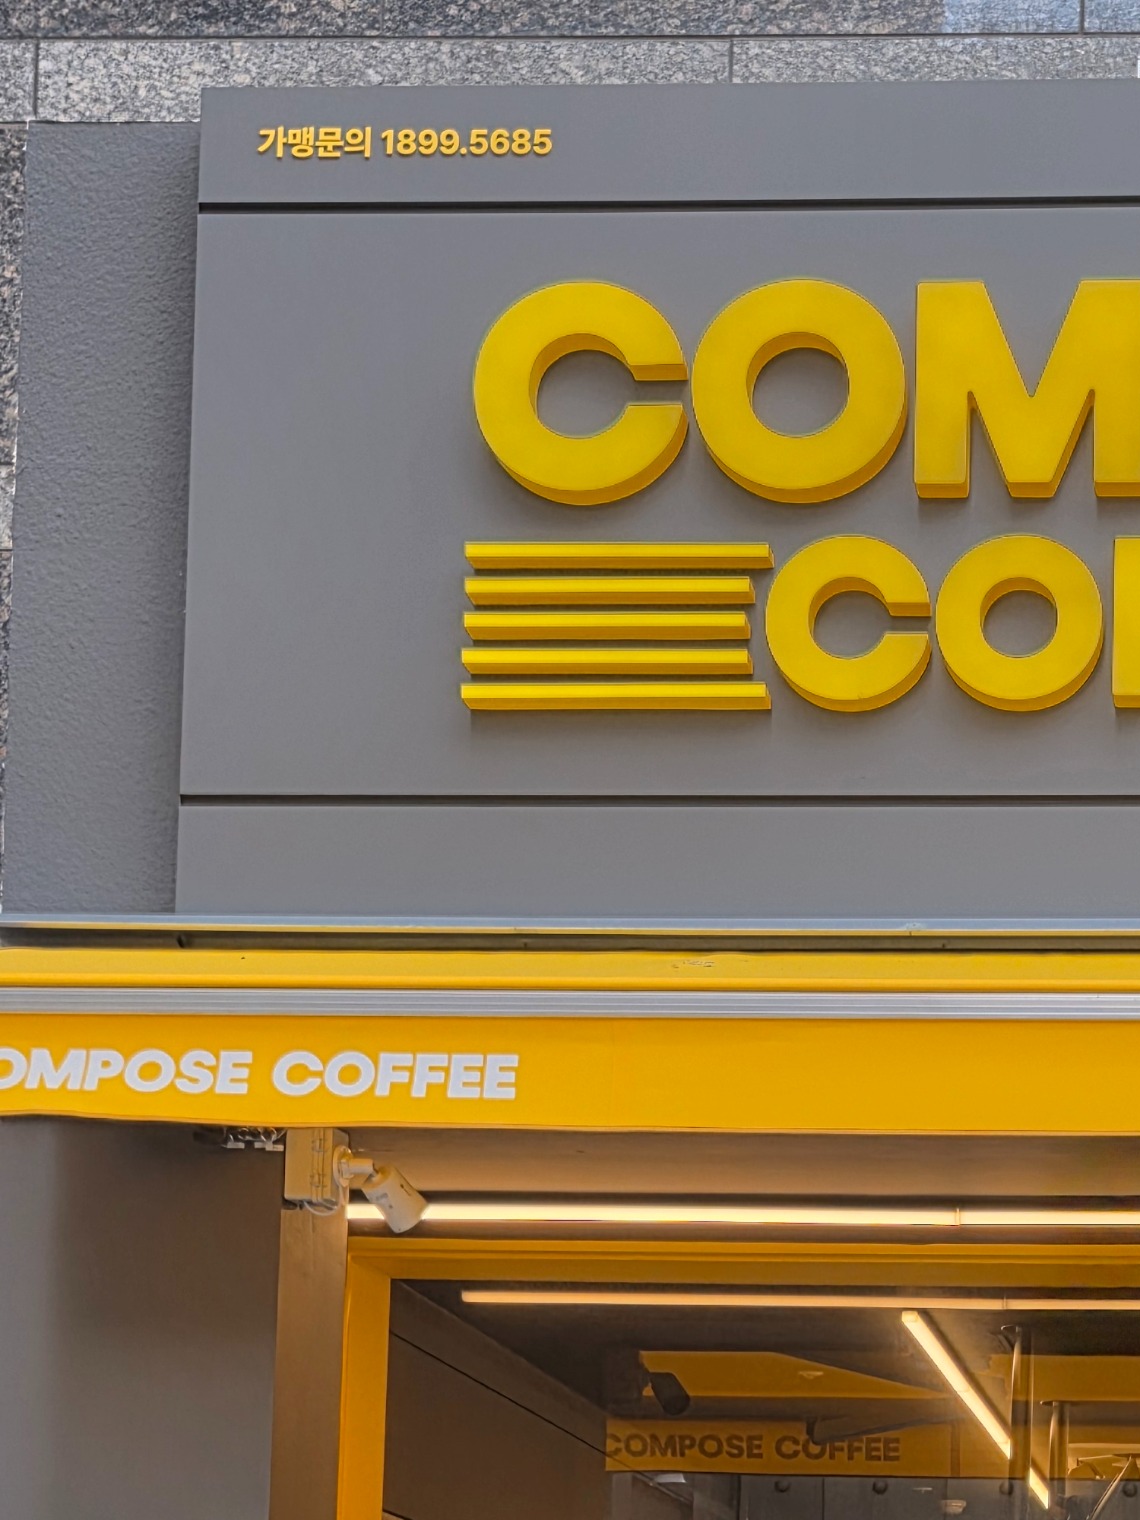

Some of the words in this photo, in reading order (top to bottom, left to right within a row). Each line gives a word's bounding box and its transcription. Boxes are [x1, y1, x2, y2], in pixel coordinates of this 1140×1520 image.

[257, 126, 372, 159] 가맹문의
[380, 128, 554, 157] 1899.5685
[272, 1051, 519, 1100] COFFEE
[604, 1432, 764, 1460] COMPOSE
[775, 1434, 901, 1462] COFFEE
